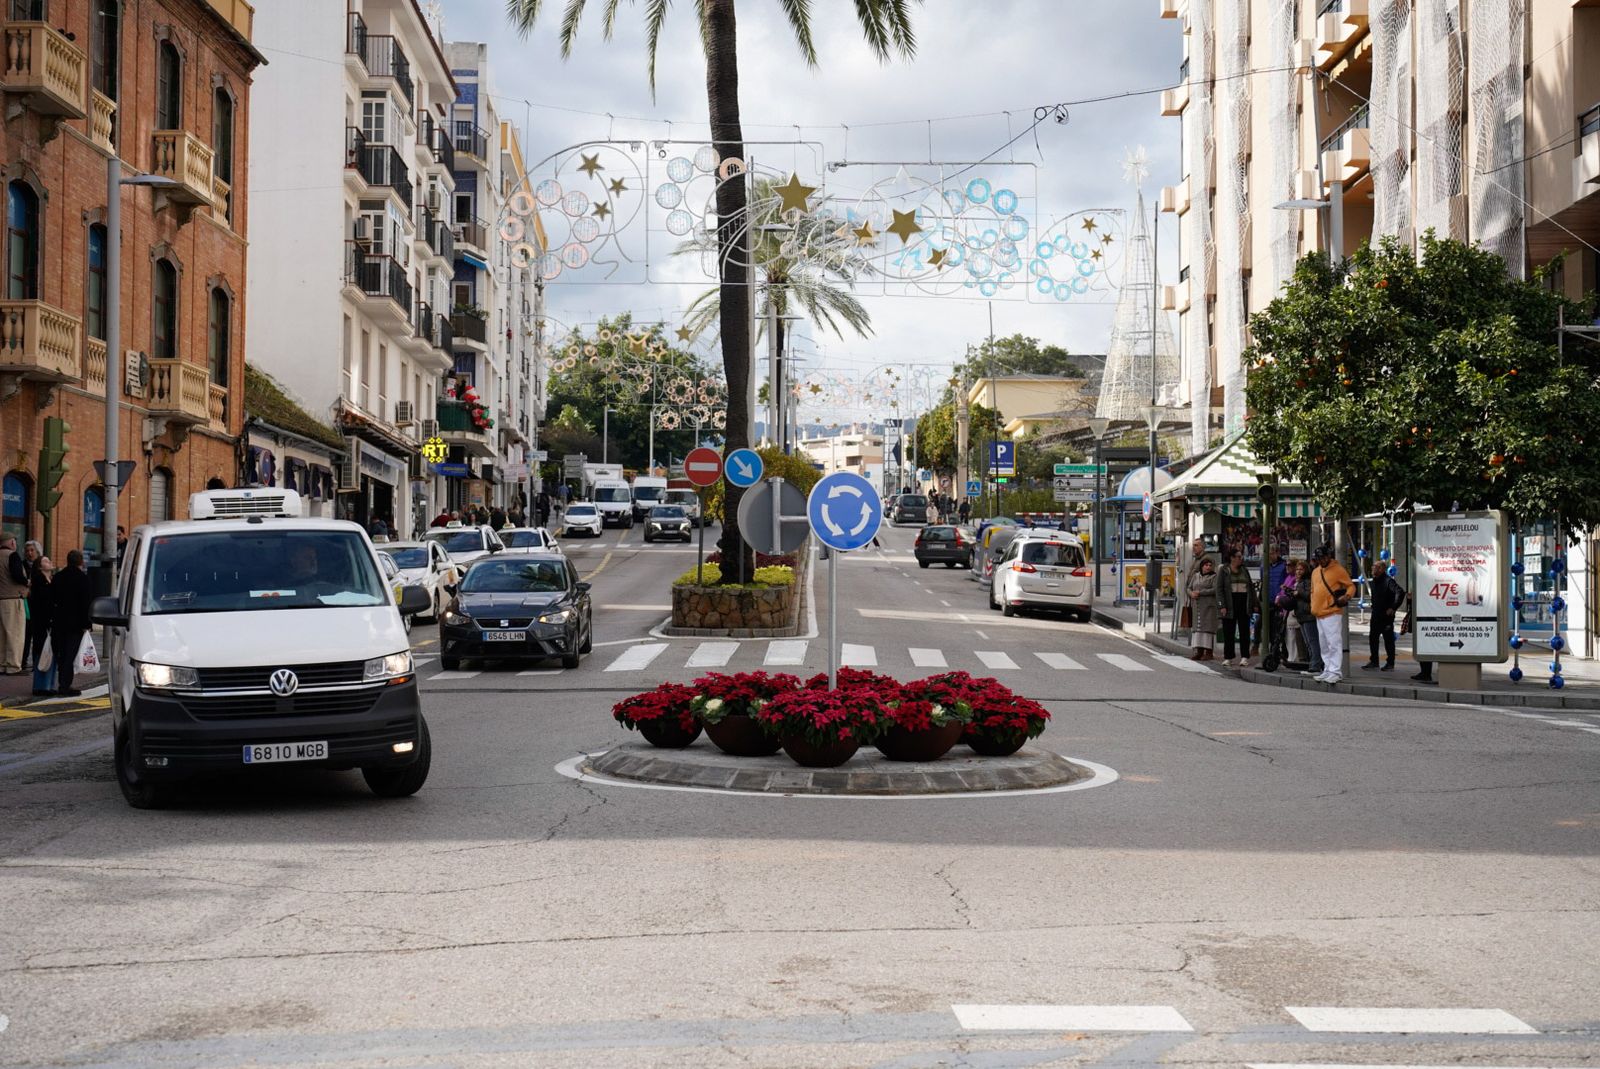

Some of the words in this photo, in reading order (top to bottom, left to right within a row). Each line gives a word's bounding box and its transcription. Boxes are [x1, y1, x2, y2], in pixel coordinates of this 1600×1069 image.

[1429, 583, 1459, 600] 47€
[254, 746, 291, 760] 6810
[296, 744, 324, 758] MGB
